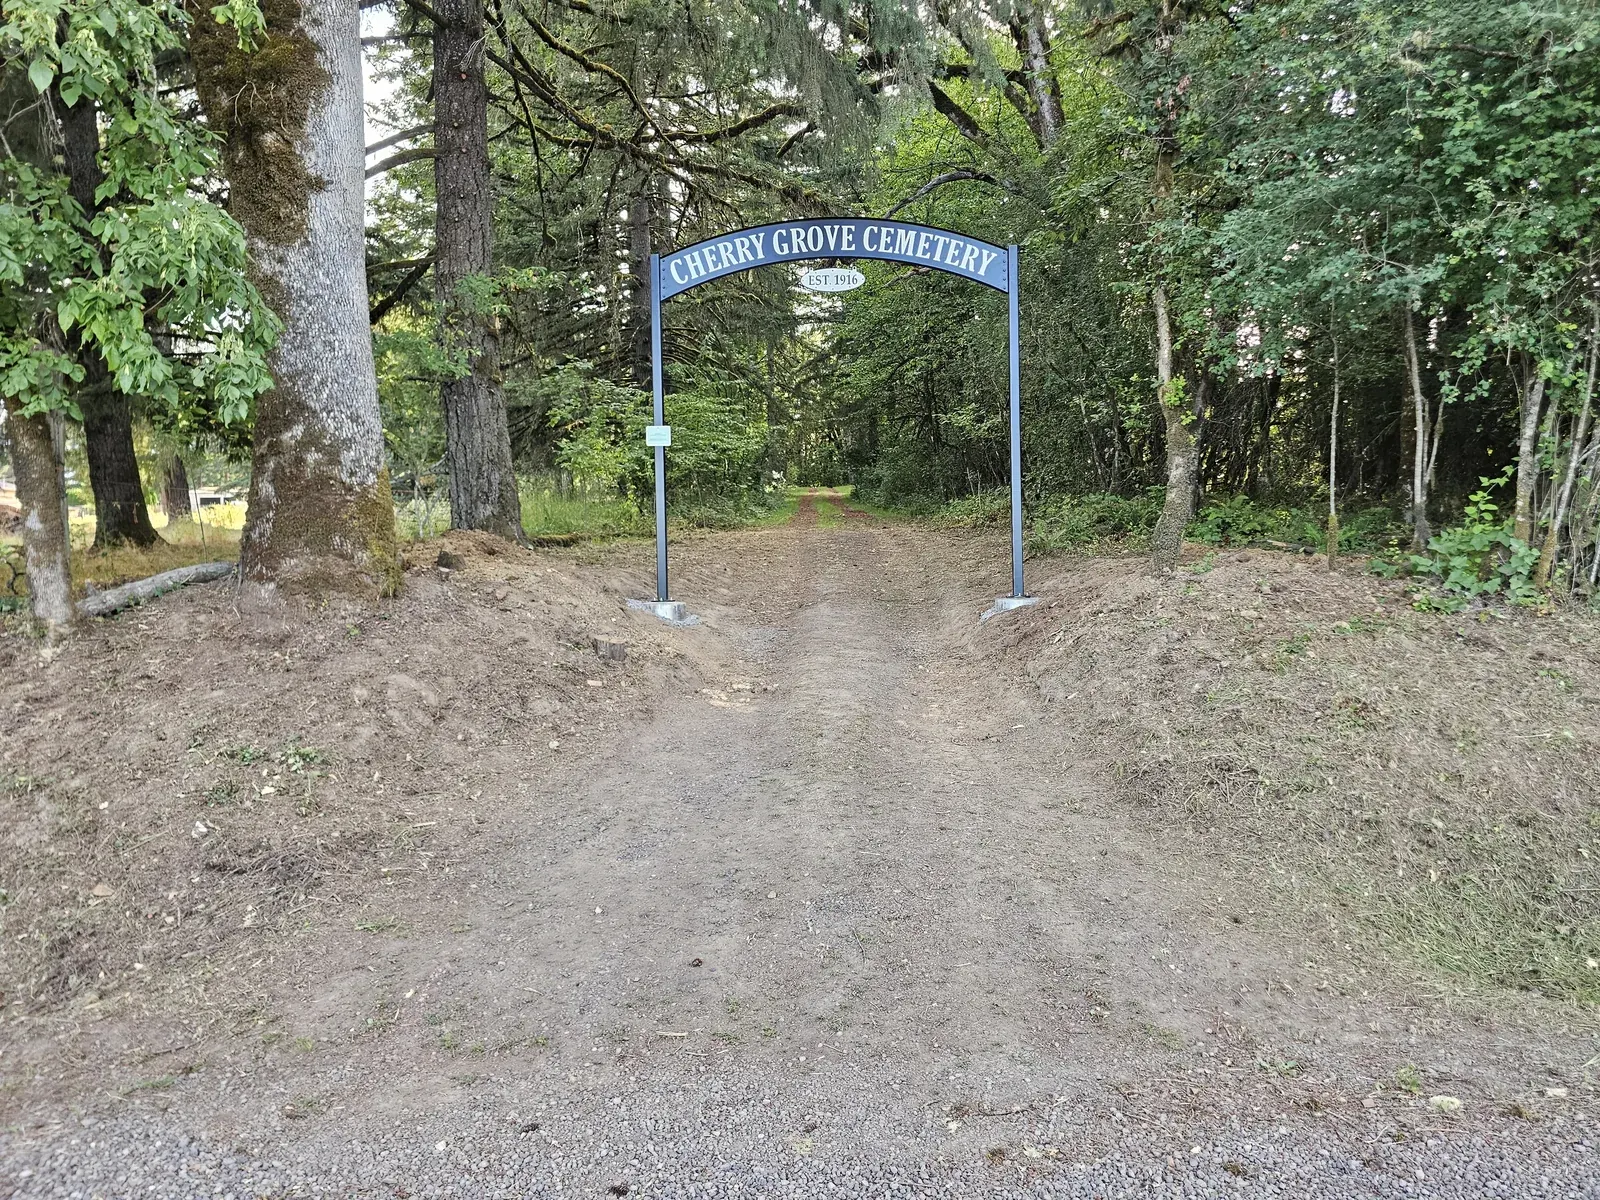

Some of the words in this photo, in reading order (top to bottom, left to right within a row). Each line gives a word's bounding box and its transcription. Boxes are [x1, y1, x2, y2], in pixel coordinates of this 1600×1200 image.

[669, 232, 766, 285] CHERRY
[772, 225, 856, 256] GROVE
[862, 225, 998, 277] CEMETERY
[808, 274, 832, 286] EST.
[834, 274, 858, 286] 1916
